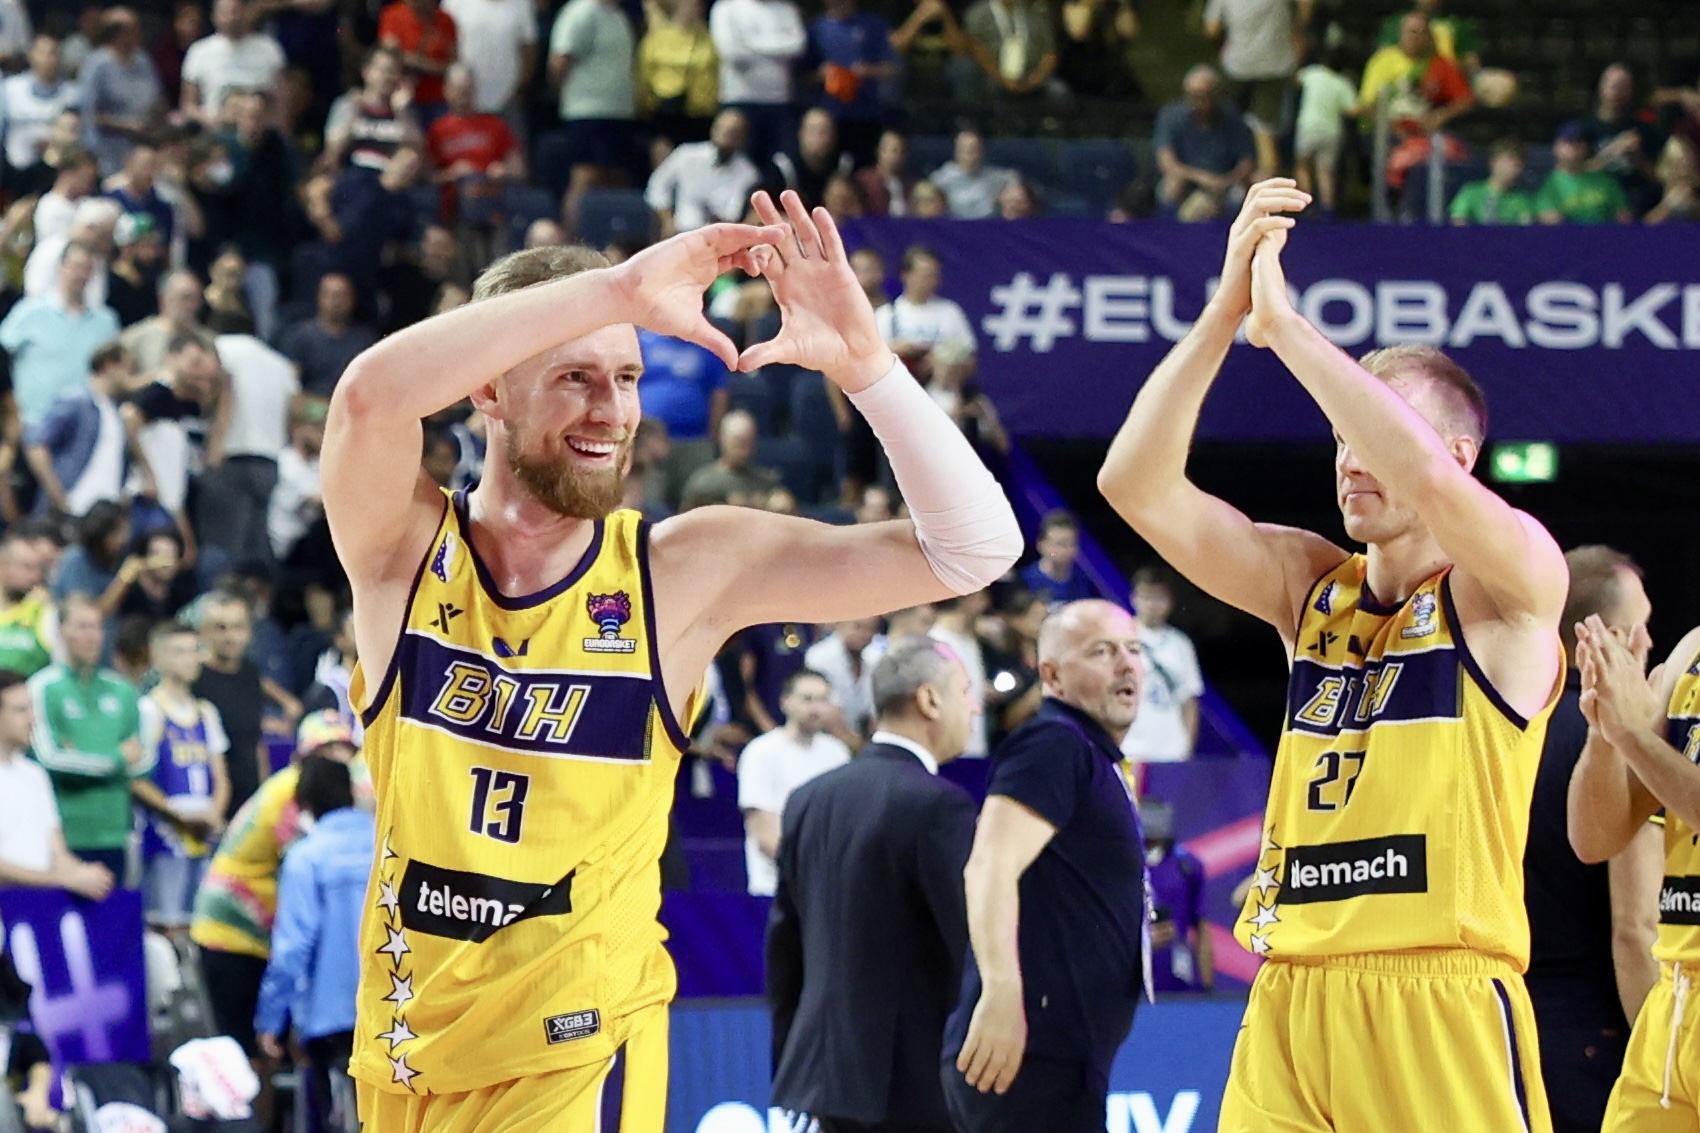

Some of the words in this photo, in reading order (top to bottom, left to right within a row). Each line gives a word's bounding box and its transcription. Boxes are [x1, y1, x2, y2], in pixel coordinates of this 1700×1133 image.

[981, 271, 1700, 350] #EUOBASK
[583, 638, 636, 650] EUROBASKET
[468, 765, 532, 845] 13
[416, 880, 527, 927] telema
[552, 1012, 593, 1033] XGB3
